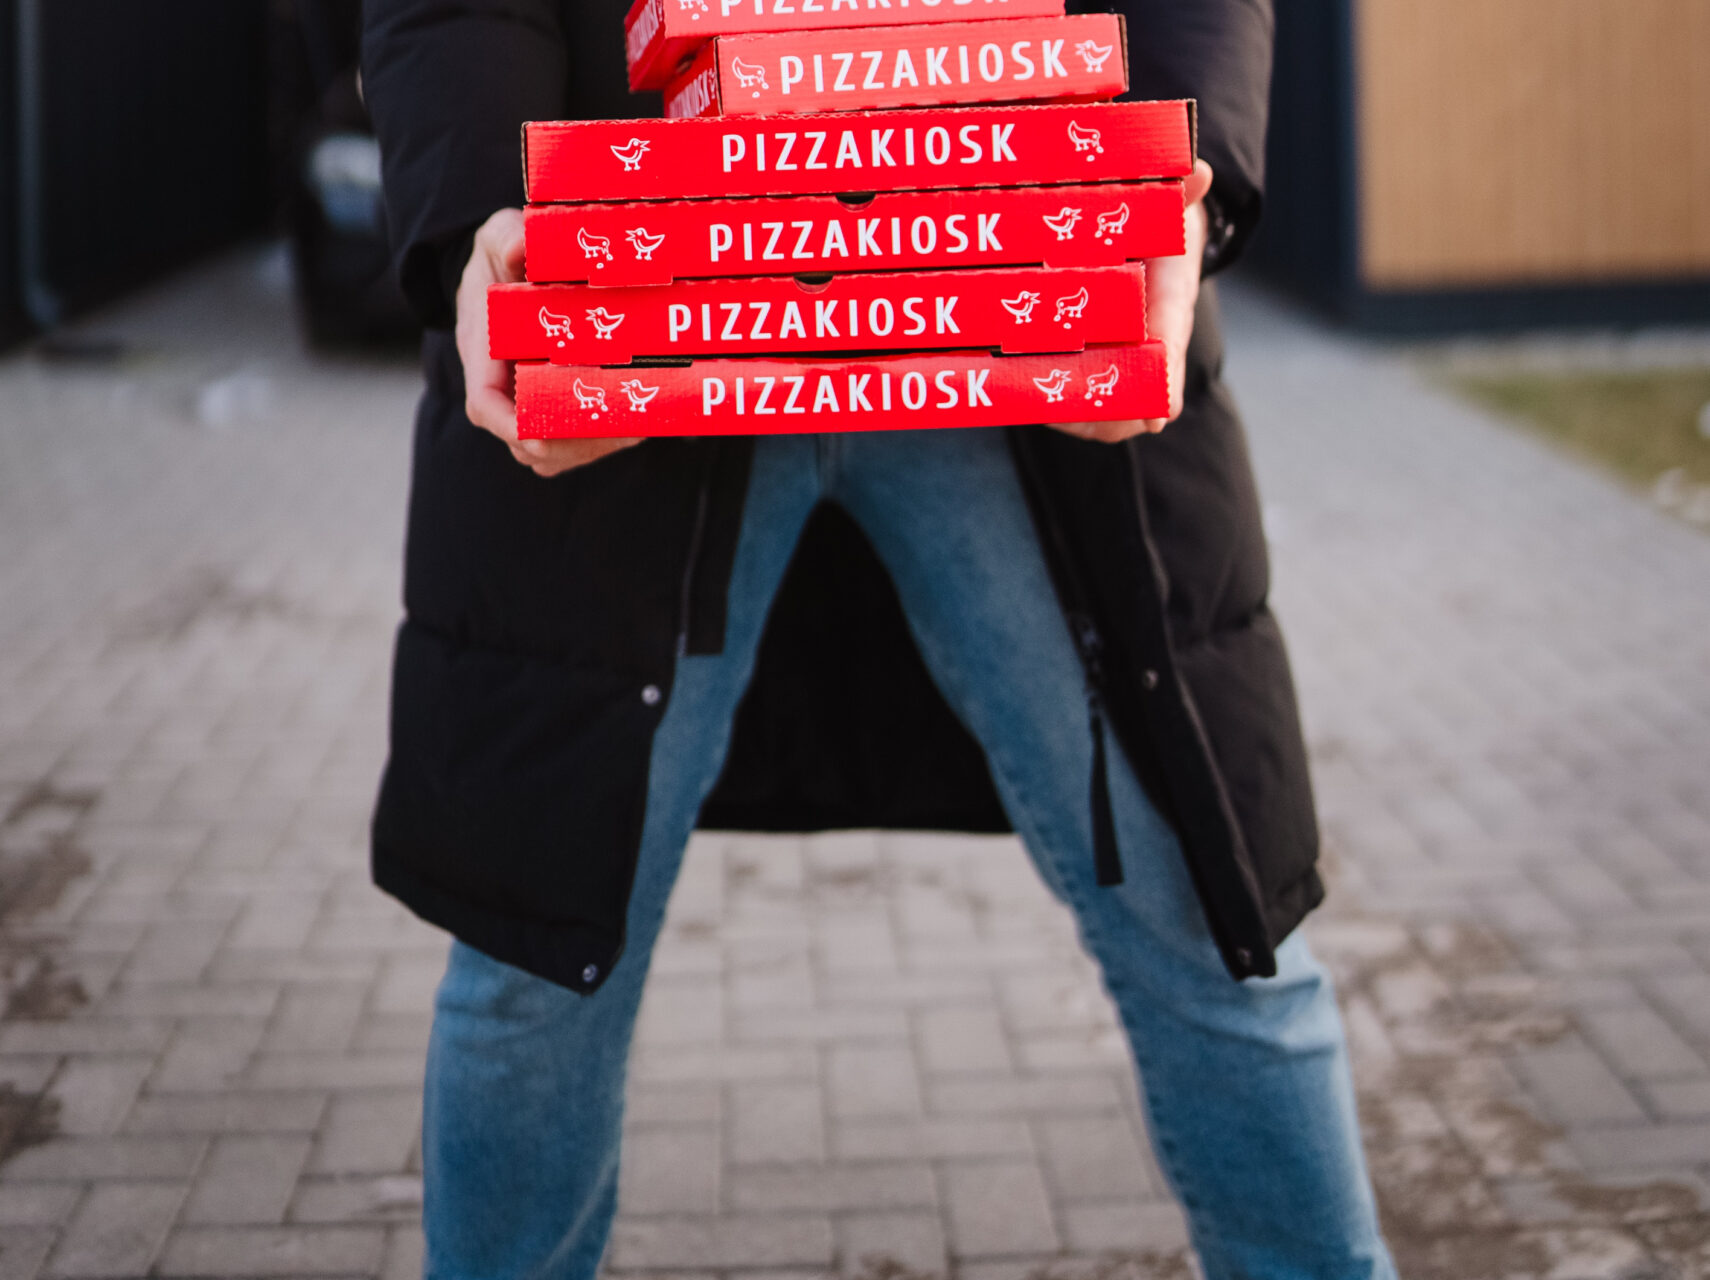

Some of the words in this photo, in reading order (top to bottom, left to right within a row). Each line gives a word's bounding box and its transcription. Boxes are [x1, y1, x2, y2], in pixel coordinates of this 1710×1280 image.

[779, 38, 1068, 95] PIZZAKIOSK
[722, 123, 1017, 172] PIZZAKIOSK
[710, 213, 1003, 262] PIZZAKIOSK
[668, 296, 960, 342] PIZZAKIOSK
[702, 369, 992, 415] PIZZAKIOSK
